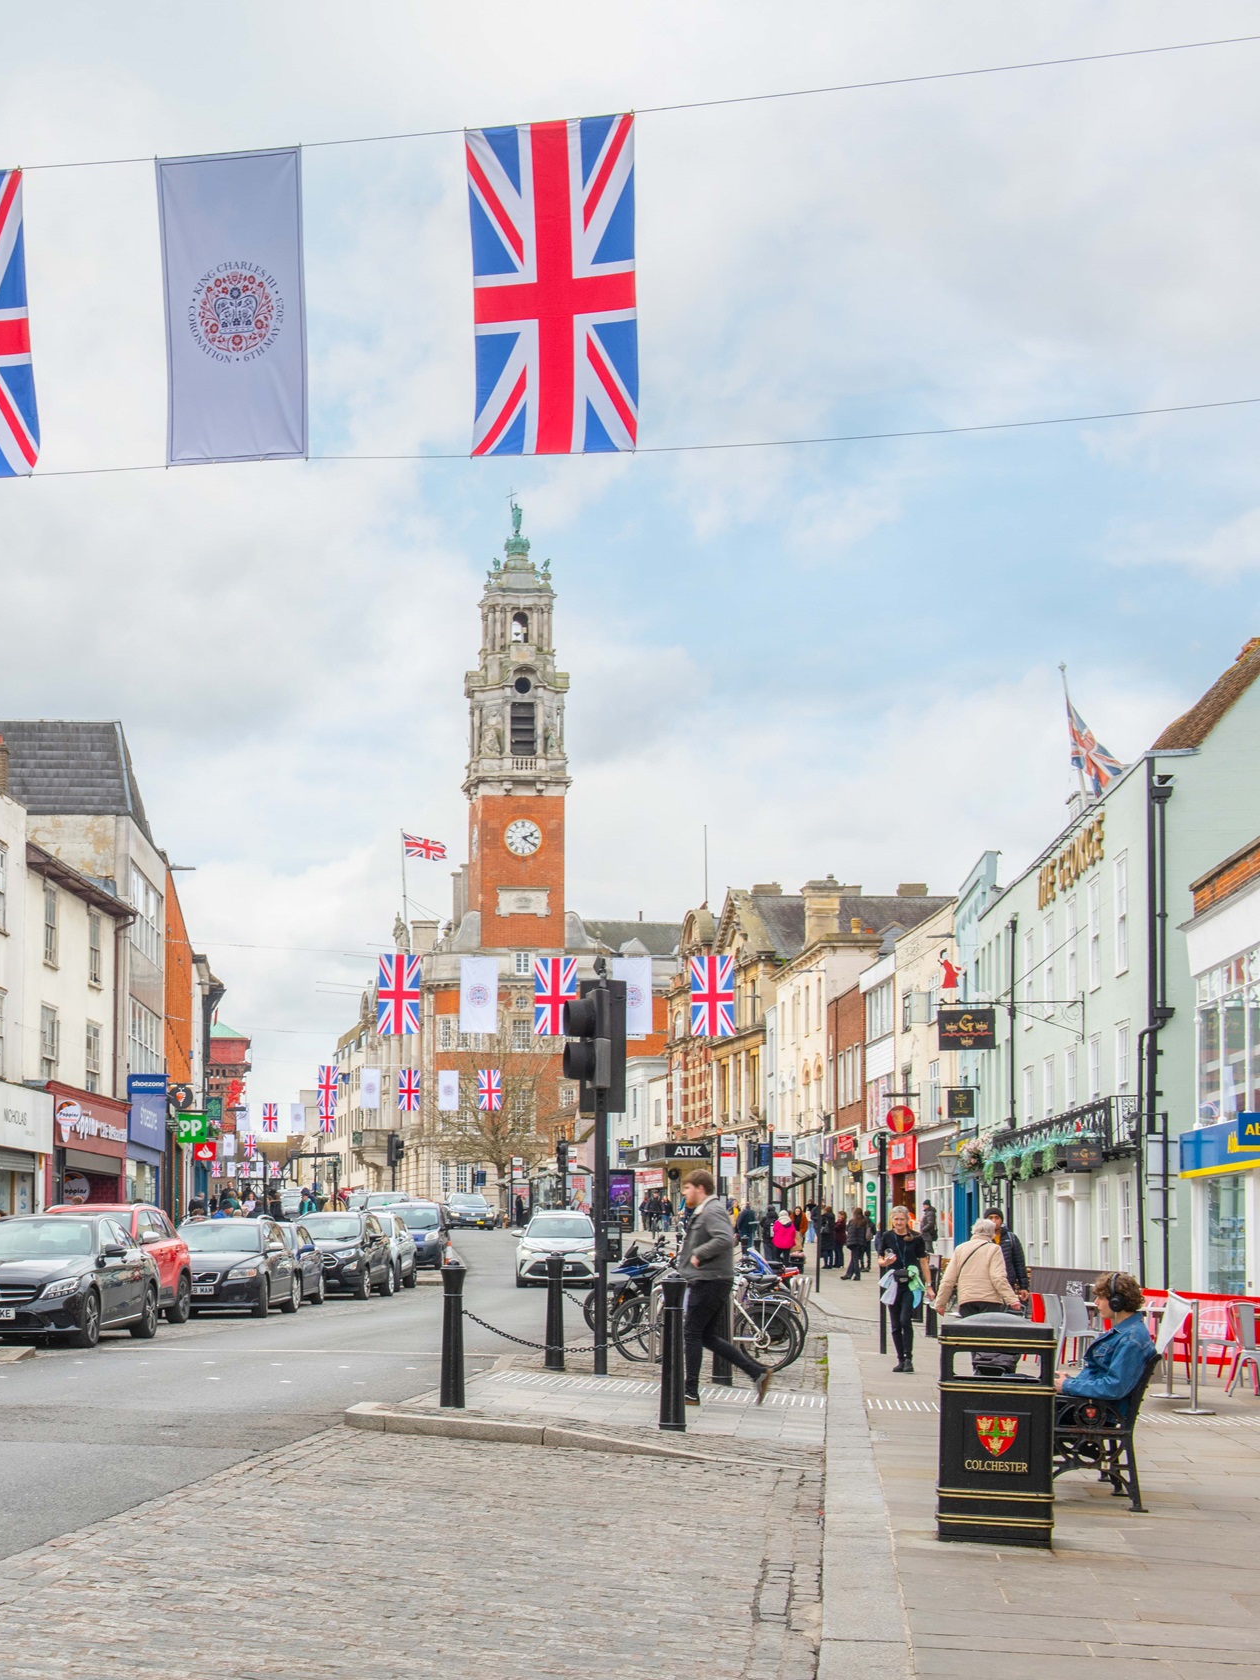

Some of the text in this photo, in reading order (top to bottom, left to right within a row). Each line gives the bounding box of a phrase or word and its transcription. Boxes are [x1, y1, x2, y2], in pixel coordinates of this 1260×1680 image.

[193, 261, 277, 295] KING CHARLES III
[188, 305, 232, 363] CORONATION
[243, 349, 265, 362] 6TH
[263, 326, 280, 348] MAY
[1037, 811, 1105, 910] THE GEORGE
[958, 1014, 974, 1032] G
[131, 1080, 165, 1088] shoezone
[3, 1108, 27, 1126] NICHOLAS
[674, 1145, 702, 1156] ATIK
[965, 1459, 1029, 1473] COLCHESTER
